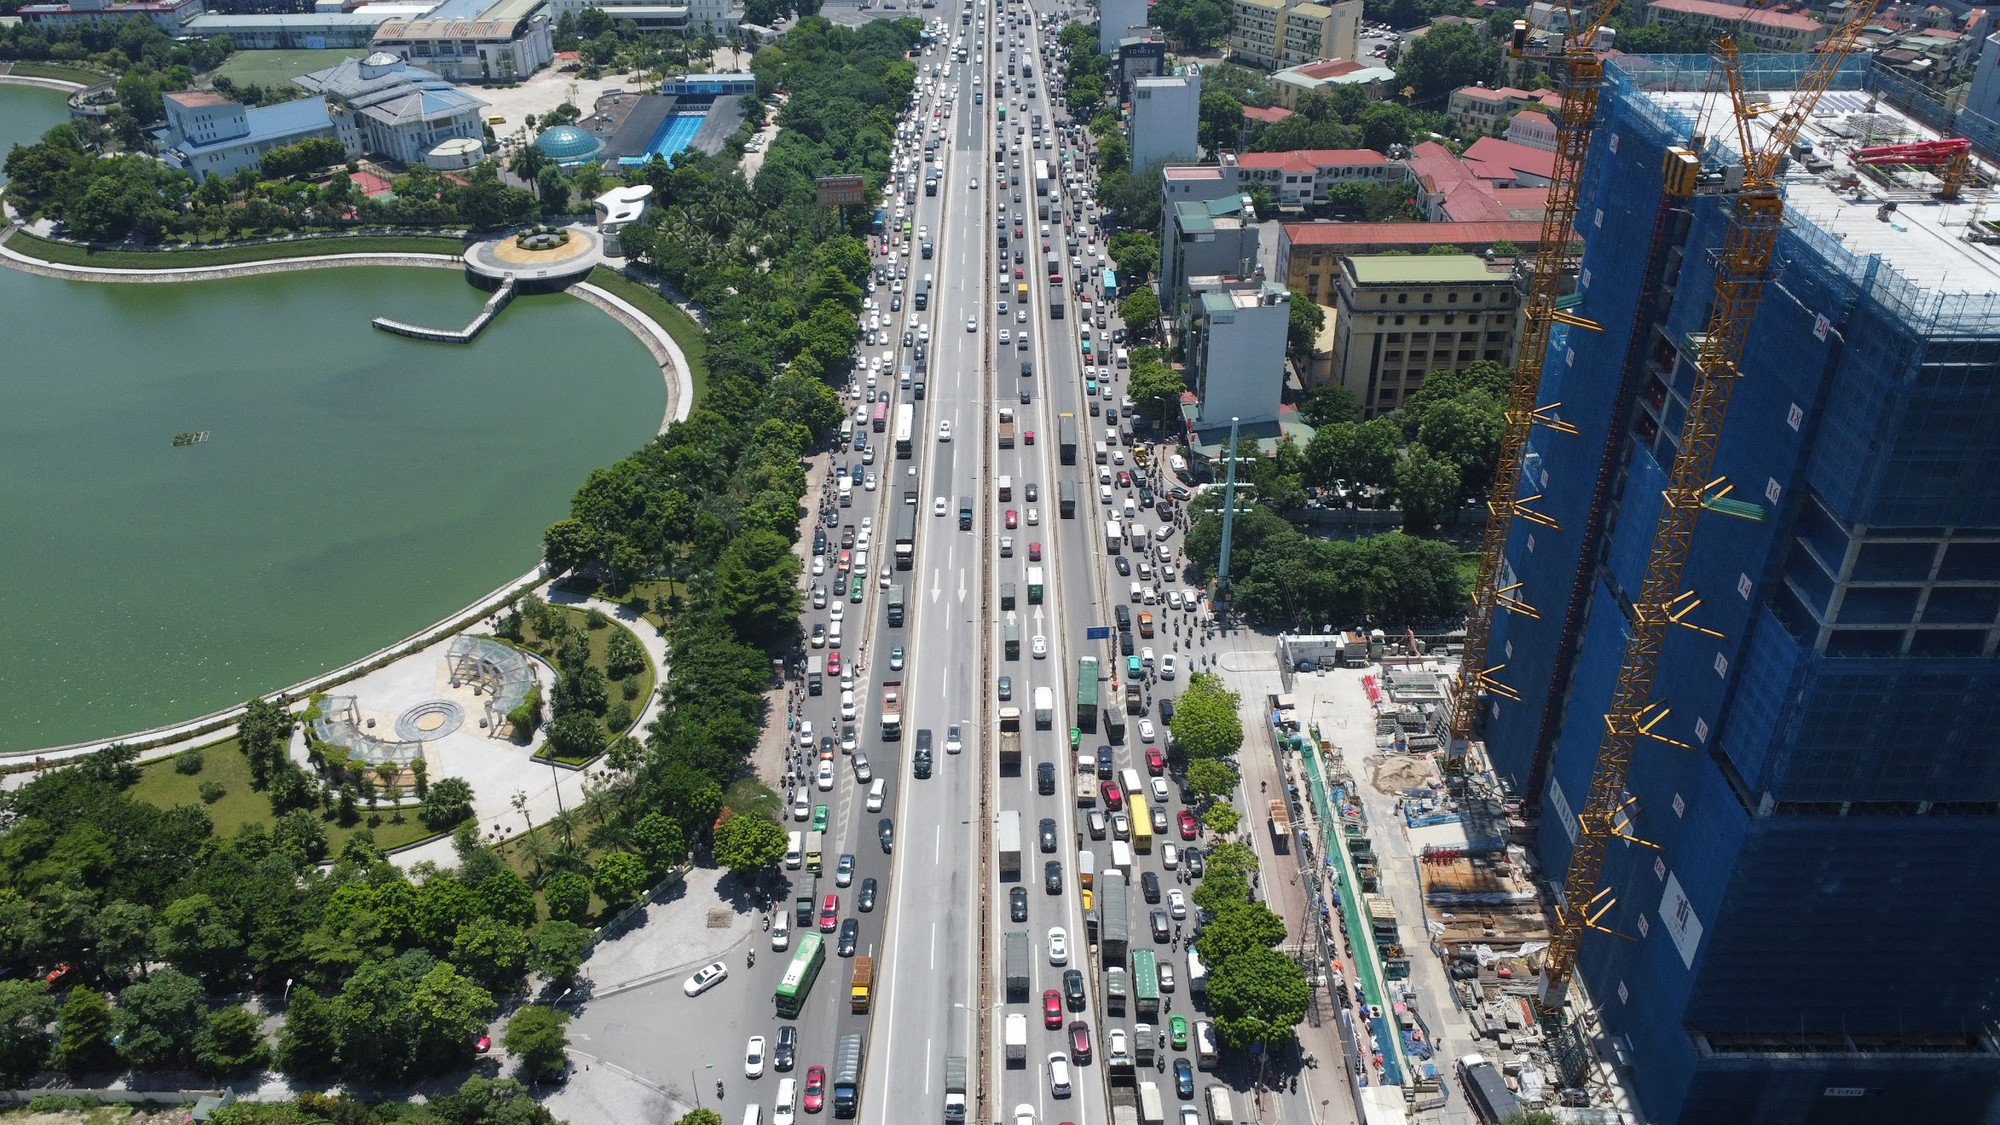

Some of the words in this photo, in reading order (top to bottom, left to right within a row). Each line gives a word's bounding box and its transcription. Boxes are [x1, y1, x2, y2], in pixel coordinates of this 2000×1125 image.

[1815, 318, 1828, 337] 20
[1790, 408, 1801, 426] 18
[1769, 483, 1779, 500] 16
[1740, 579, 1751, 596] 14
[1717, 657, 1727, 675] 12
[1655, 860, 1665, 878] 06
